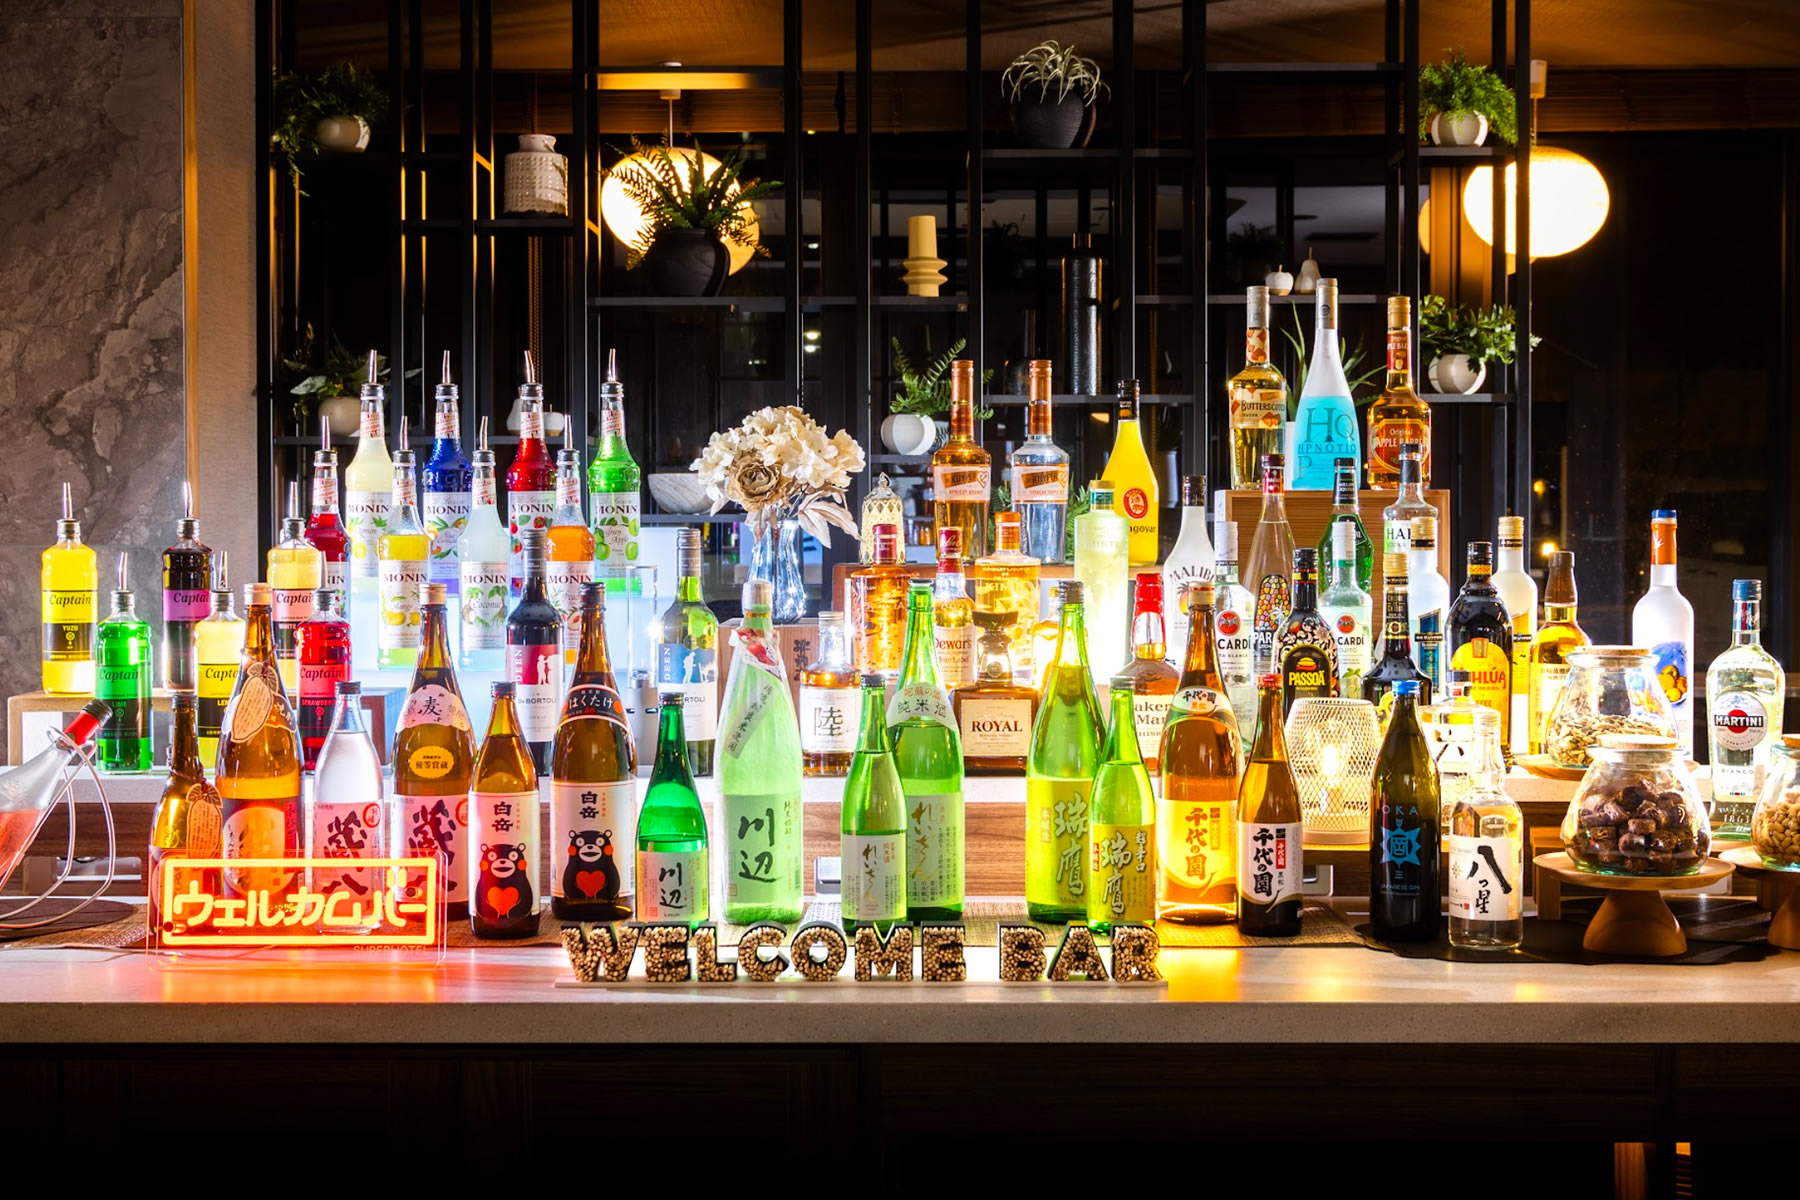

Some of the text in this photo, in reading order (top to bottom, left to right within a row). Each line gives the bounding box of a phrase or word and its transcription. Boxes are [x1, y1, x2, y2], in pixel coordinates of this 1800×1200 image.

[1390, 428, 1413, 436] Original
[348, 504, 389, 513] MONIN
[427, 505, 470, 515] MONIN
[511, 503, 554, 513] MONIN
[595, 504, 637, 514] MONIN
[384, 573, 427, 583] MONIN
[463, 574, 507, 584] MONIN
[548, 575, 592, 584] MONIN
[49, 594, 92, 607] Captain
[173, 592, 210, 605] Captai
[276, 592, 312, 606] Captai
[1217, 636, 1252, 650] CARDÍ
[1337, 634, 1365, 646] CARDÍ
[514, 650, 523, 682] DEEN
[663, 647, 671, 681] DEEN
[300, 667, 342, 681] Captain
[1472, 666, 1506, 690] HLÚA
[423, 695, 441, 716] 麦
[569, 694, 613, 710] はくたけ
[813, 706, 844, 737] 陸
[971, 720, 1023, 733] ROYAL
[1715, 715, 1763, 727] MARTINI
[579, 791, 599, 819] 白岳
[1381, 804, 1419, 816] OKA
[491, 801, 513, 832] 白岳
[737, 807, 784, 883] 川辺
[1135, 830, 1147, 872] 超辛口
[1185, 807, 1208, 881] 千代の園
[1253, 828, 1274, 897] 千代の園
[658, 862, 688, 909] 川辺
[173, 868, 427, 928] ウェルカムバー
[561, 922, 1164, 983] WELCOME BAR
